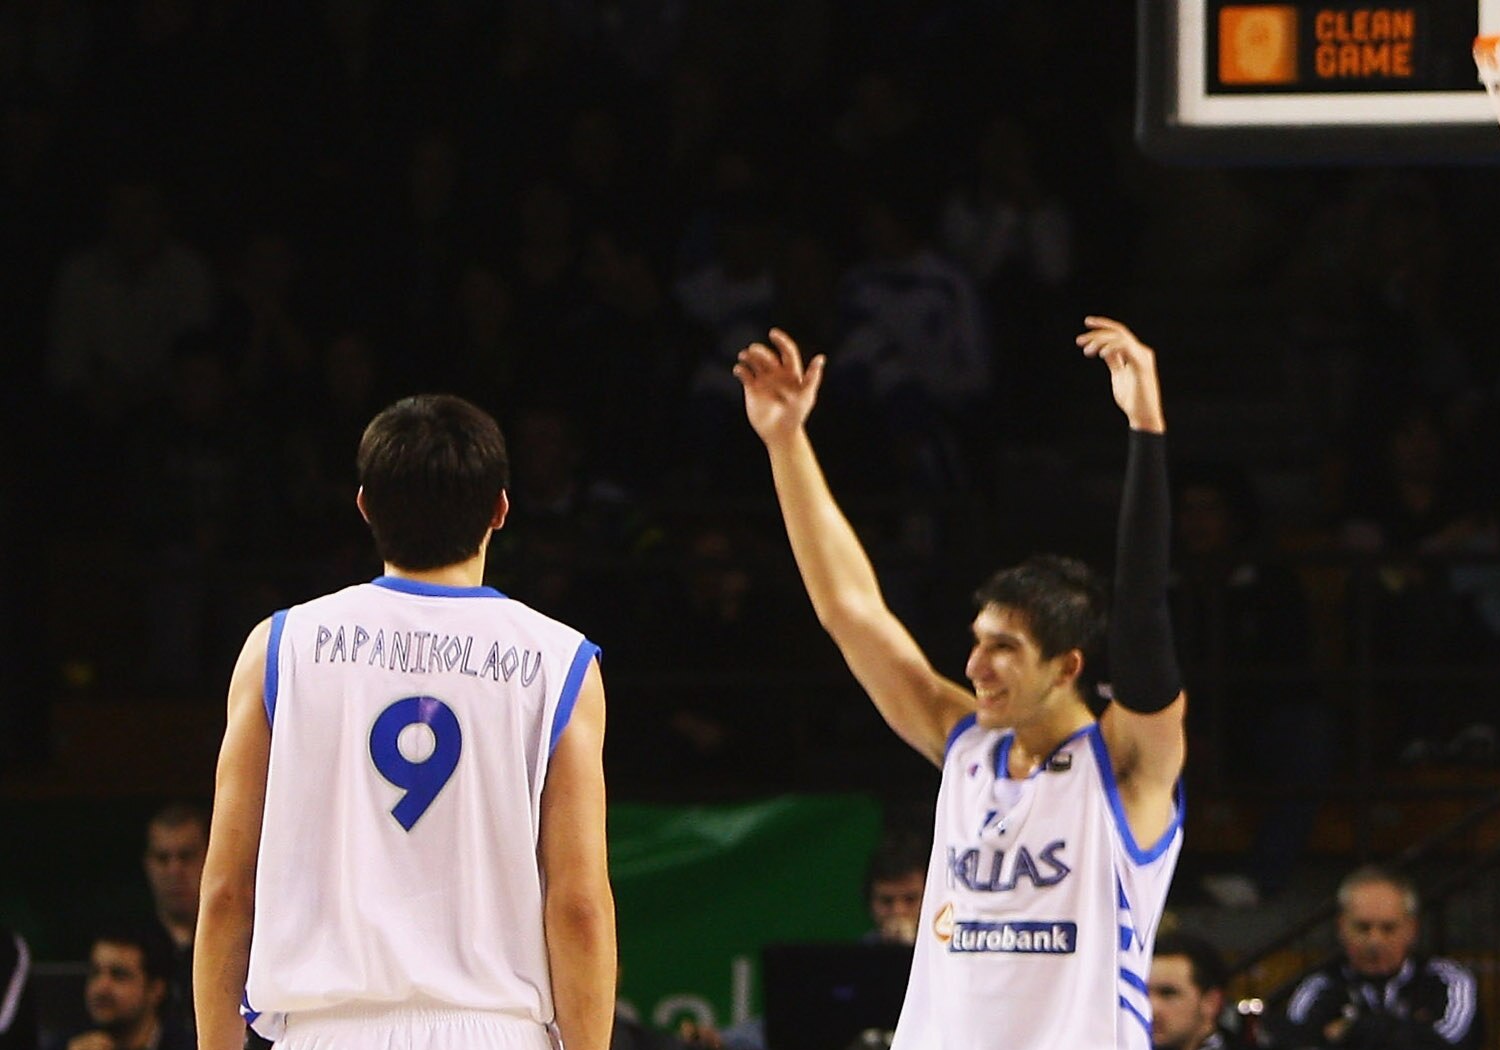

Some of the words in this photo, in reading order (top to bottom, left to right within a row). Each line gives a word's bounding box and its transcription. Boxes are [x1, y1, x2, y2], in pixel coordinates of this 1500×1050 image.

[1316, 8, 1414, 40] CLEAN
[1315, 43, 1412, 77] GAME
[313, 624, 543, 688] PAPANIKOLAOU
[368, 695, 463, 832] 9
